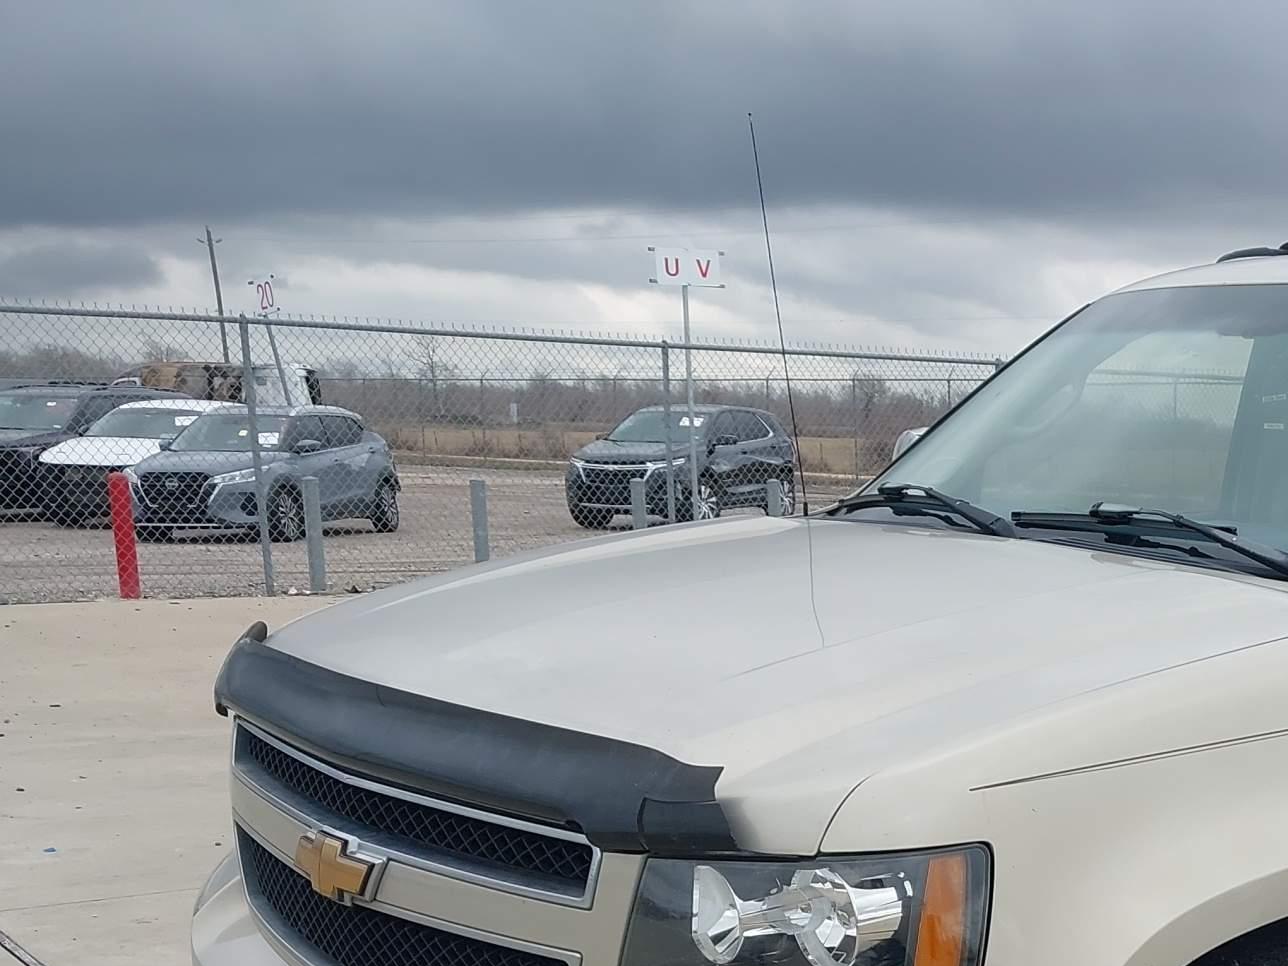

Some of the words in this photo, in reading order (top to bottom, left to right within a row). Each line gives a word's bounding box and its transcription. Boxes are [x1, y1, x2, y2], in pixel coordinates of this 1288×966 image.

[664, 257, 679, 277] U
[696, 259, 710, 278] V
[256, 281, 274, 310] 20
